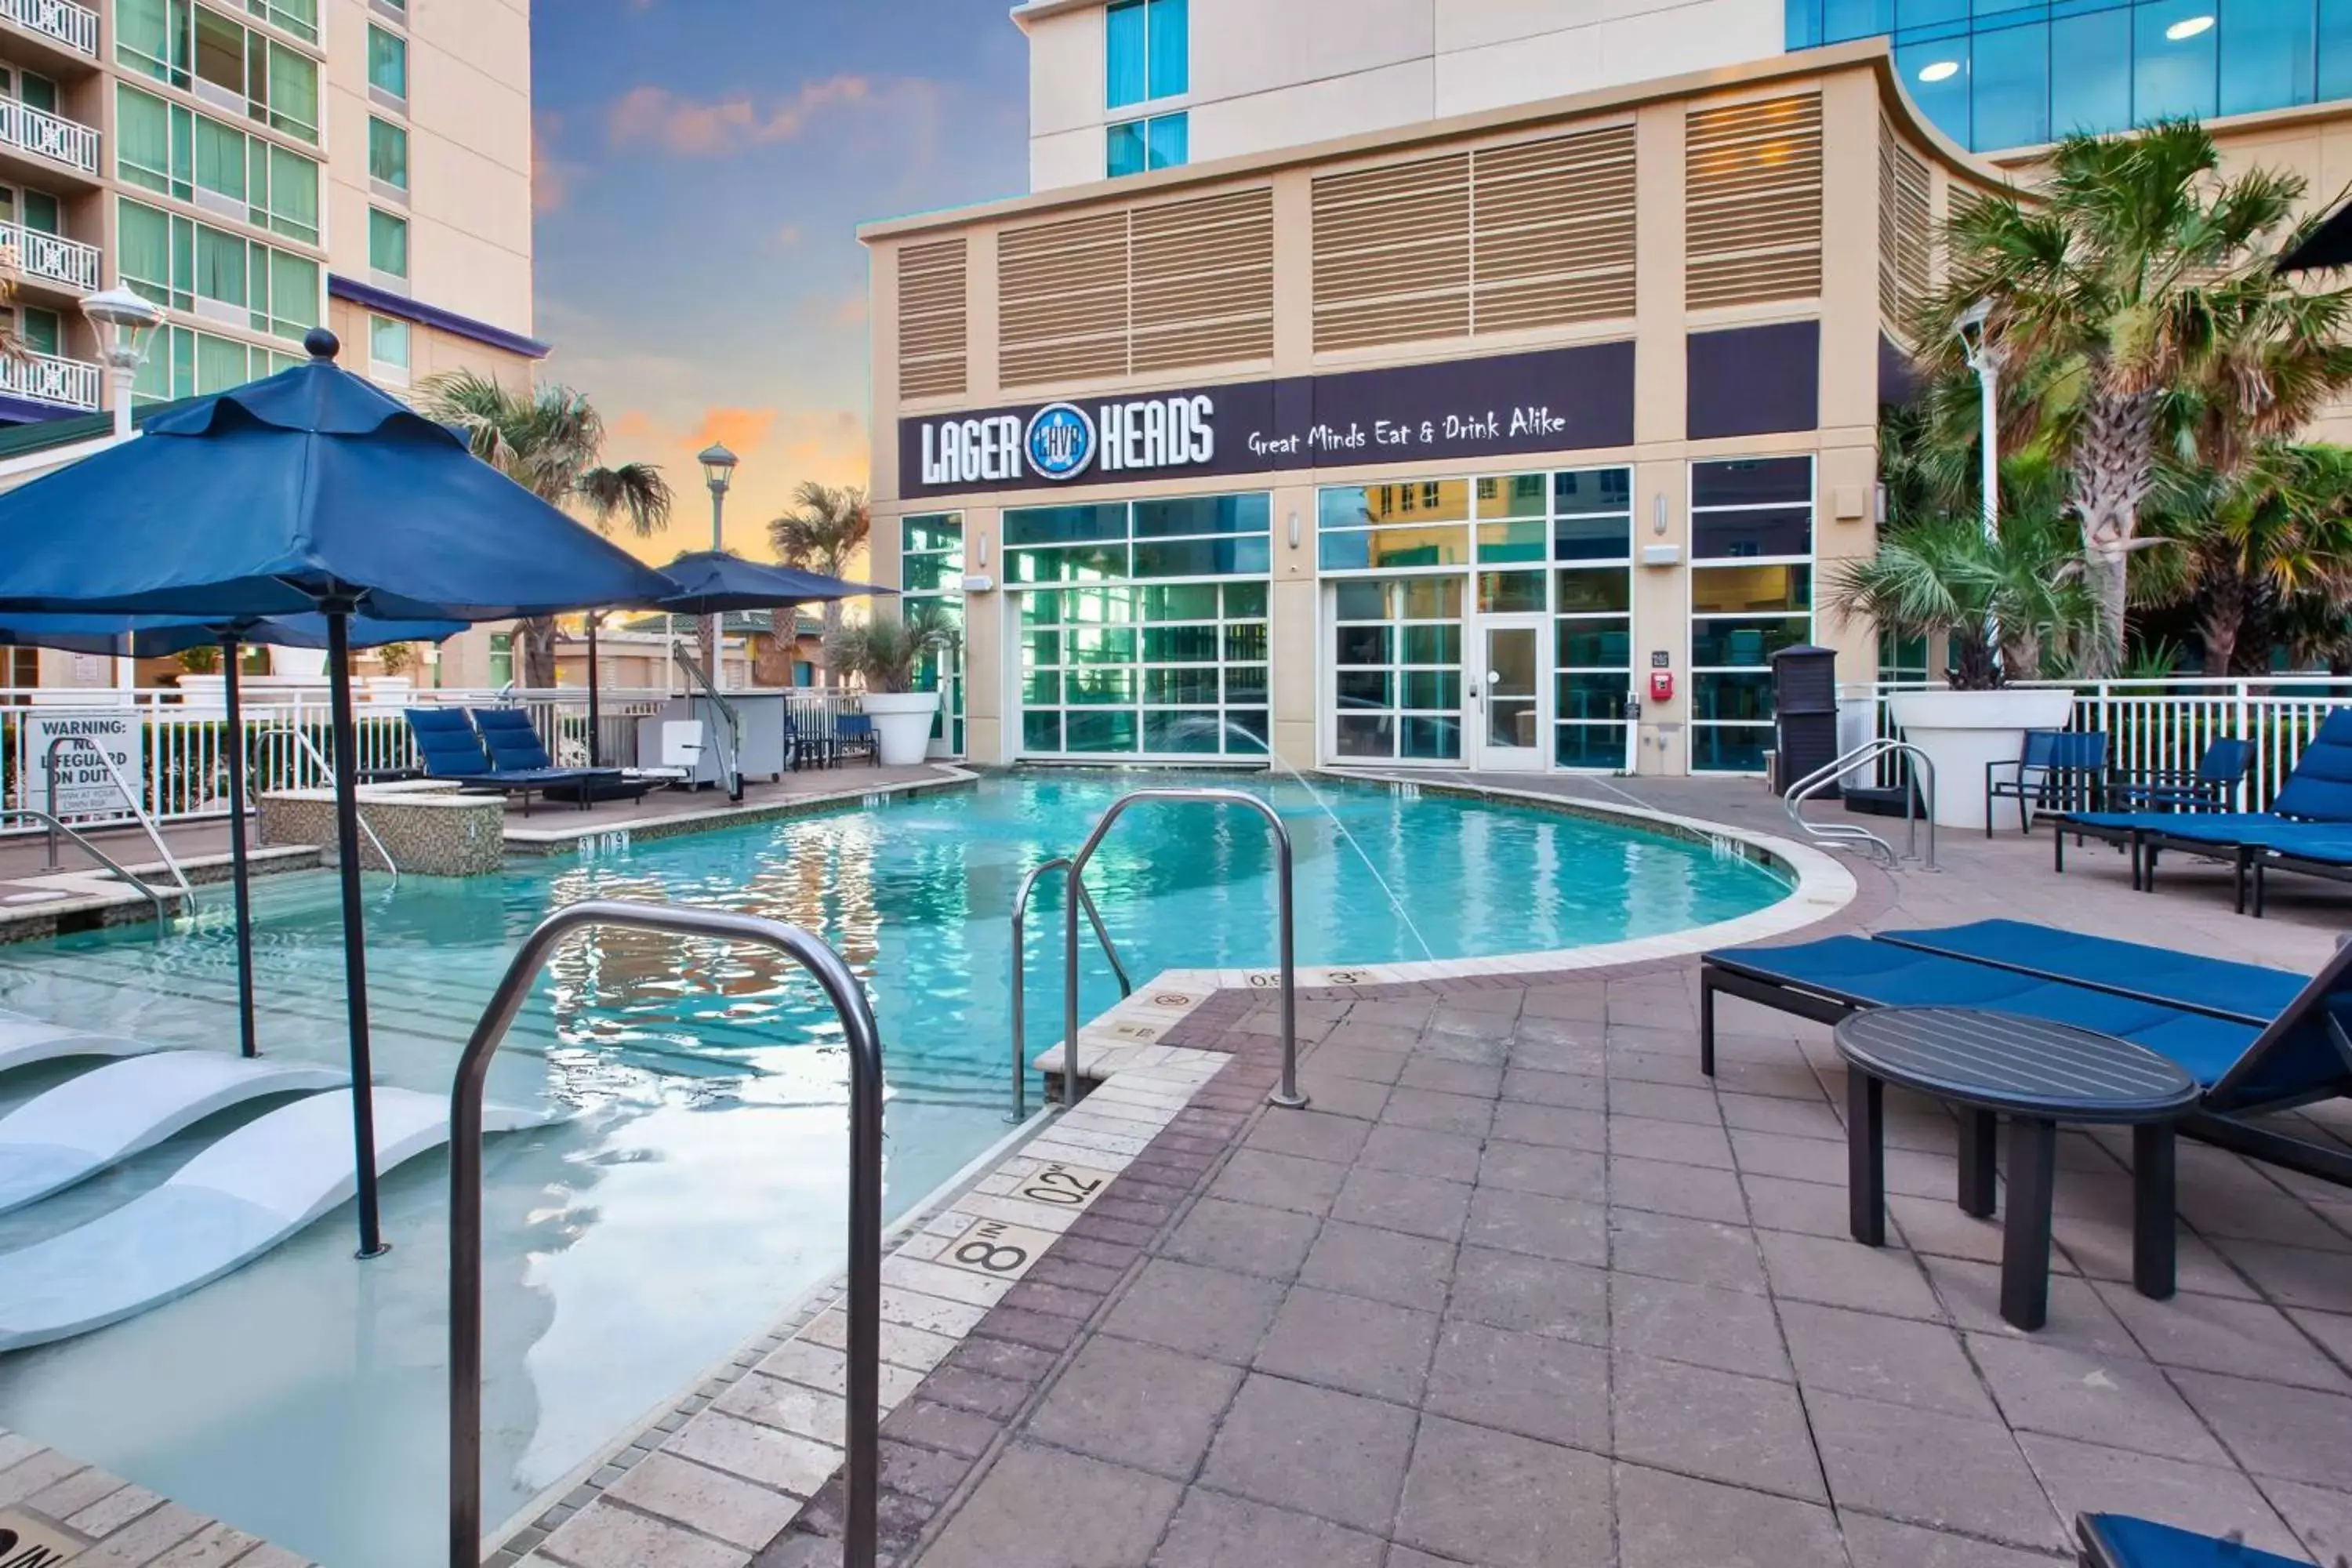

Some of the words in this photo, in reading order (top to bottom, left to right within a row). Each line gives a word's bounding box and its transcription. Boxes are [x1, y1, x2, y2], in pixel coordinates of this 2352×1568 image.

[921, 415, 1022, 485] LAGER
[1100, 394, 1214, 470] HEADS
[1248, 431, 1300, 456] Great
[1308, 423, 1366, 452] Minds
[1374, 420, 1411, 445] Eat
[1420, 421, 1436, 444] &
[1443, 411, 1500, 440] Drink
[1509, 406, 1566, 437] Alike
[42, 720, 126, 735] WARNING:
[41, 752, 127, 769] LFEGUARD
[955, 1241, 1027, 1272] 8
